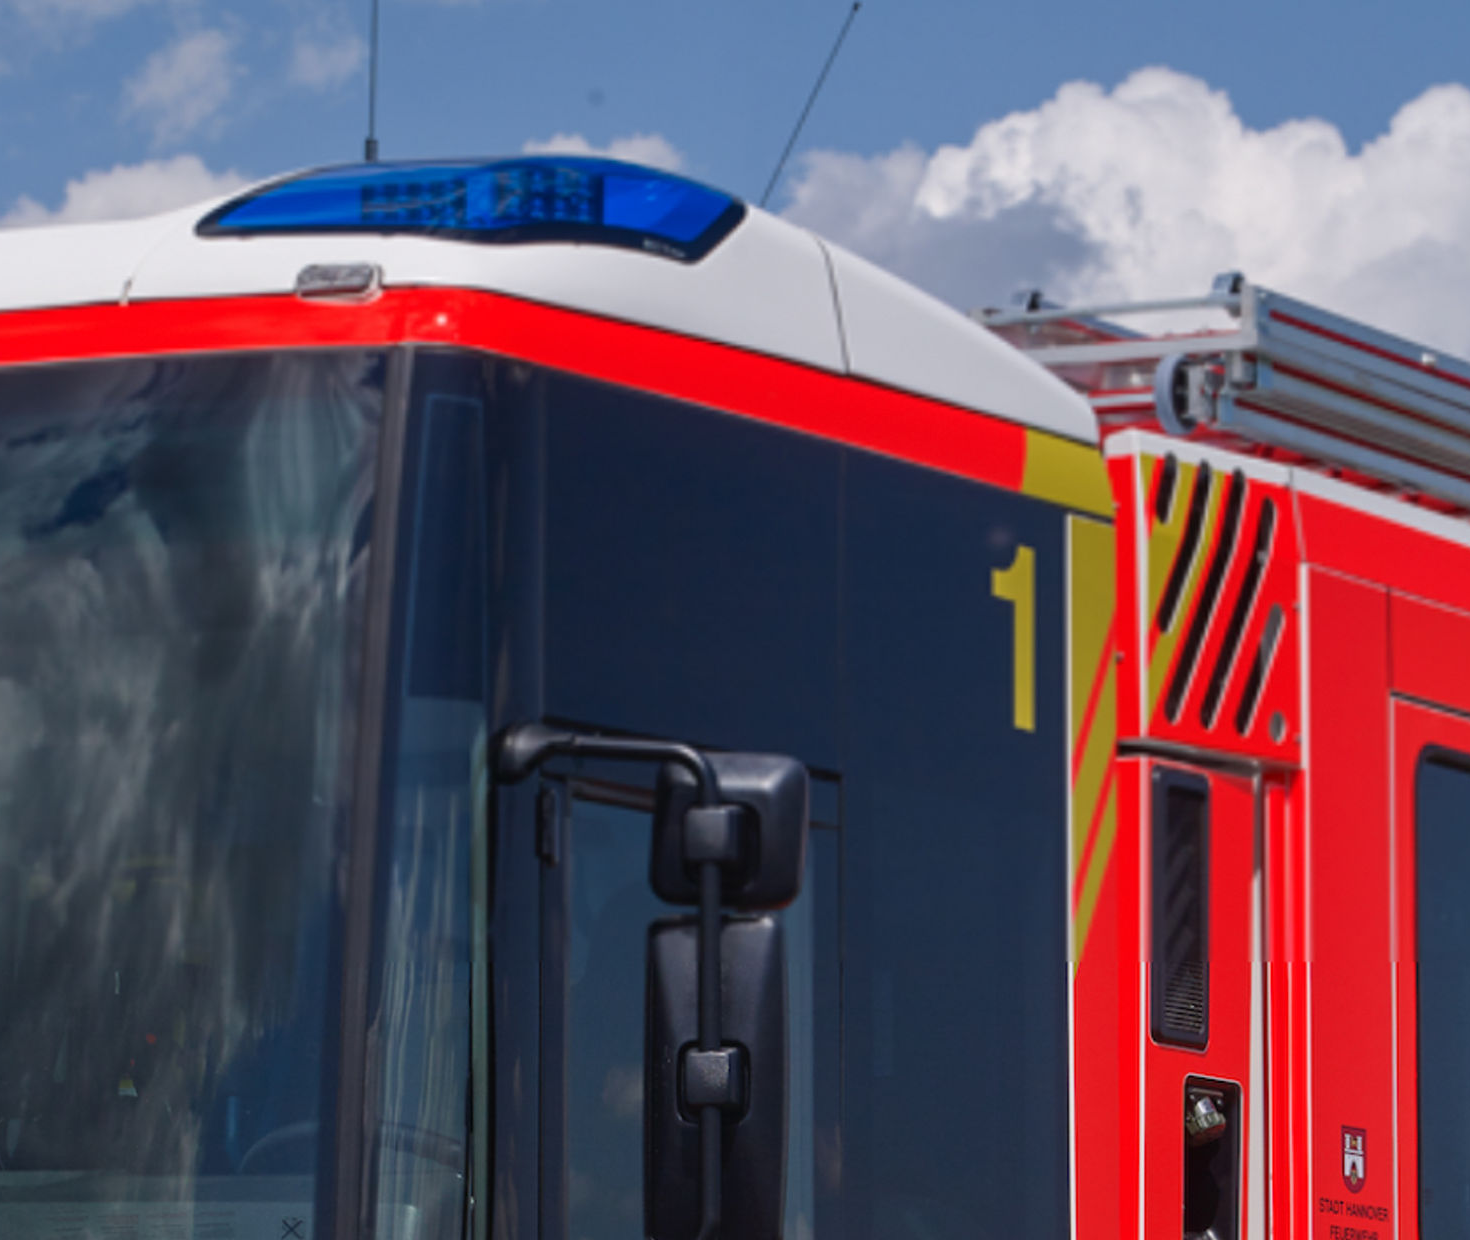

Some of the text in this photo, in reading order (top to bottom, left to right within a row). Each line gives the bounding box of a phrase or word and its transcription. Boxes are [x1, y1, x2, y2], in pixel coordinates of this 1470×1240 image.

[991, 545, 1035, 733] 1
[1319, 1197, 1389, 1222] STADT HANNOVER
